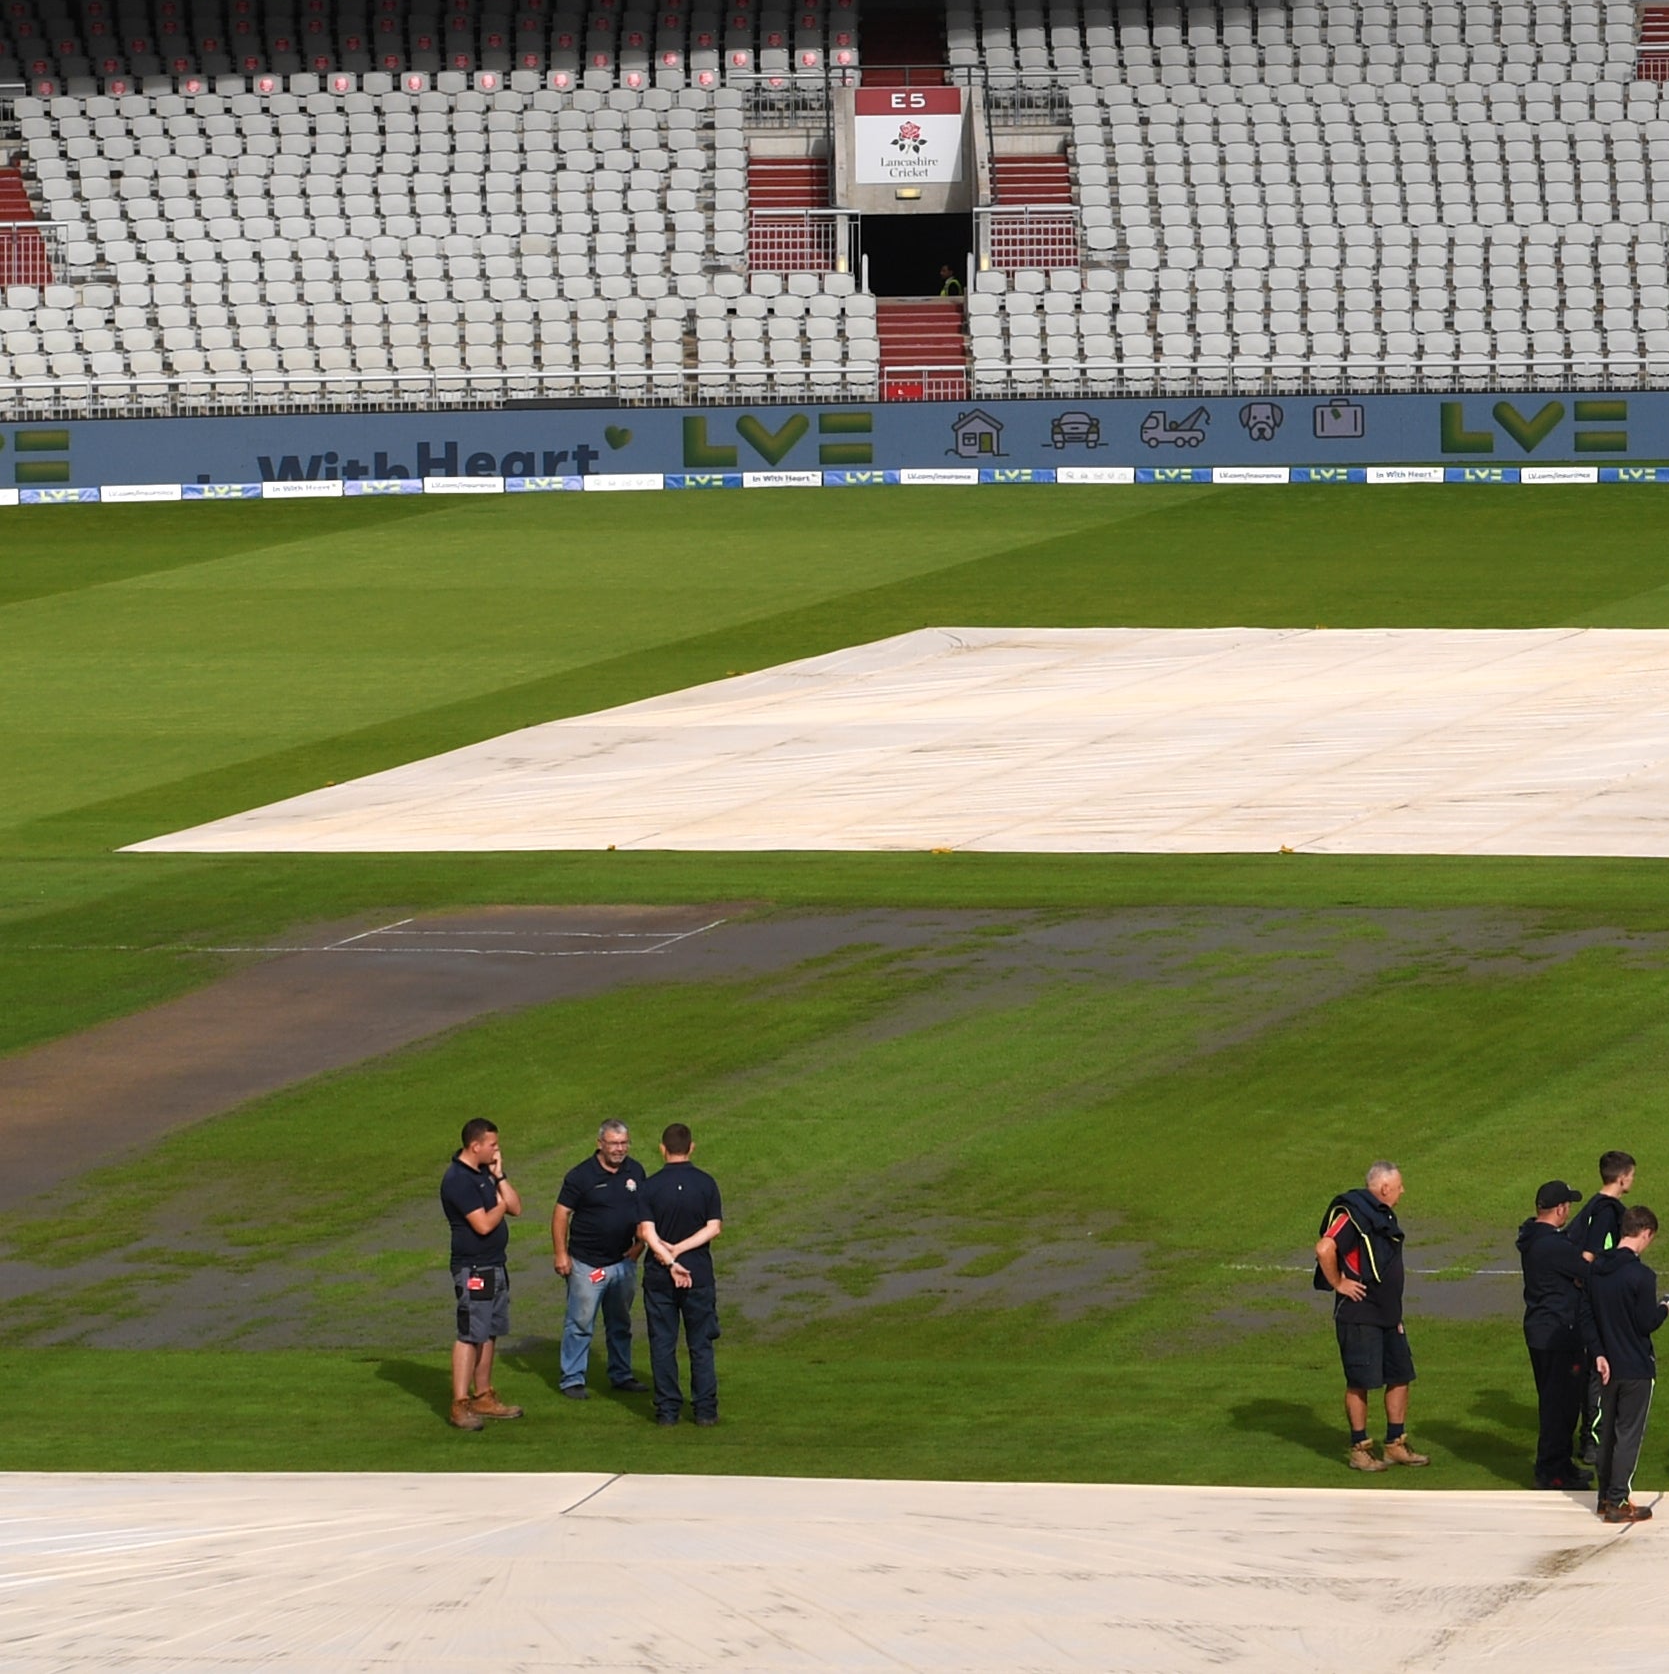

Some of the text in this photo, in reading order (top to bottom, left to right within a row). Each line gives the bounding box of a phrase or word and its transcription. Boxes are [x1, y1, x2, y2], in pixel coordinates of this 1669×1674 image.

[890, 93, 926, 108] E5
[880, 156, 938, 167] Lancashire
[889, 168, 929, 178] Cricket
[752, 475, 810, 483] In With Heart
